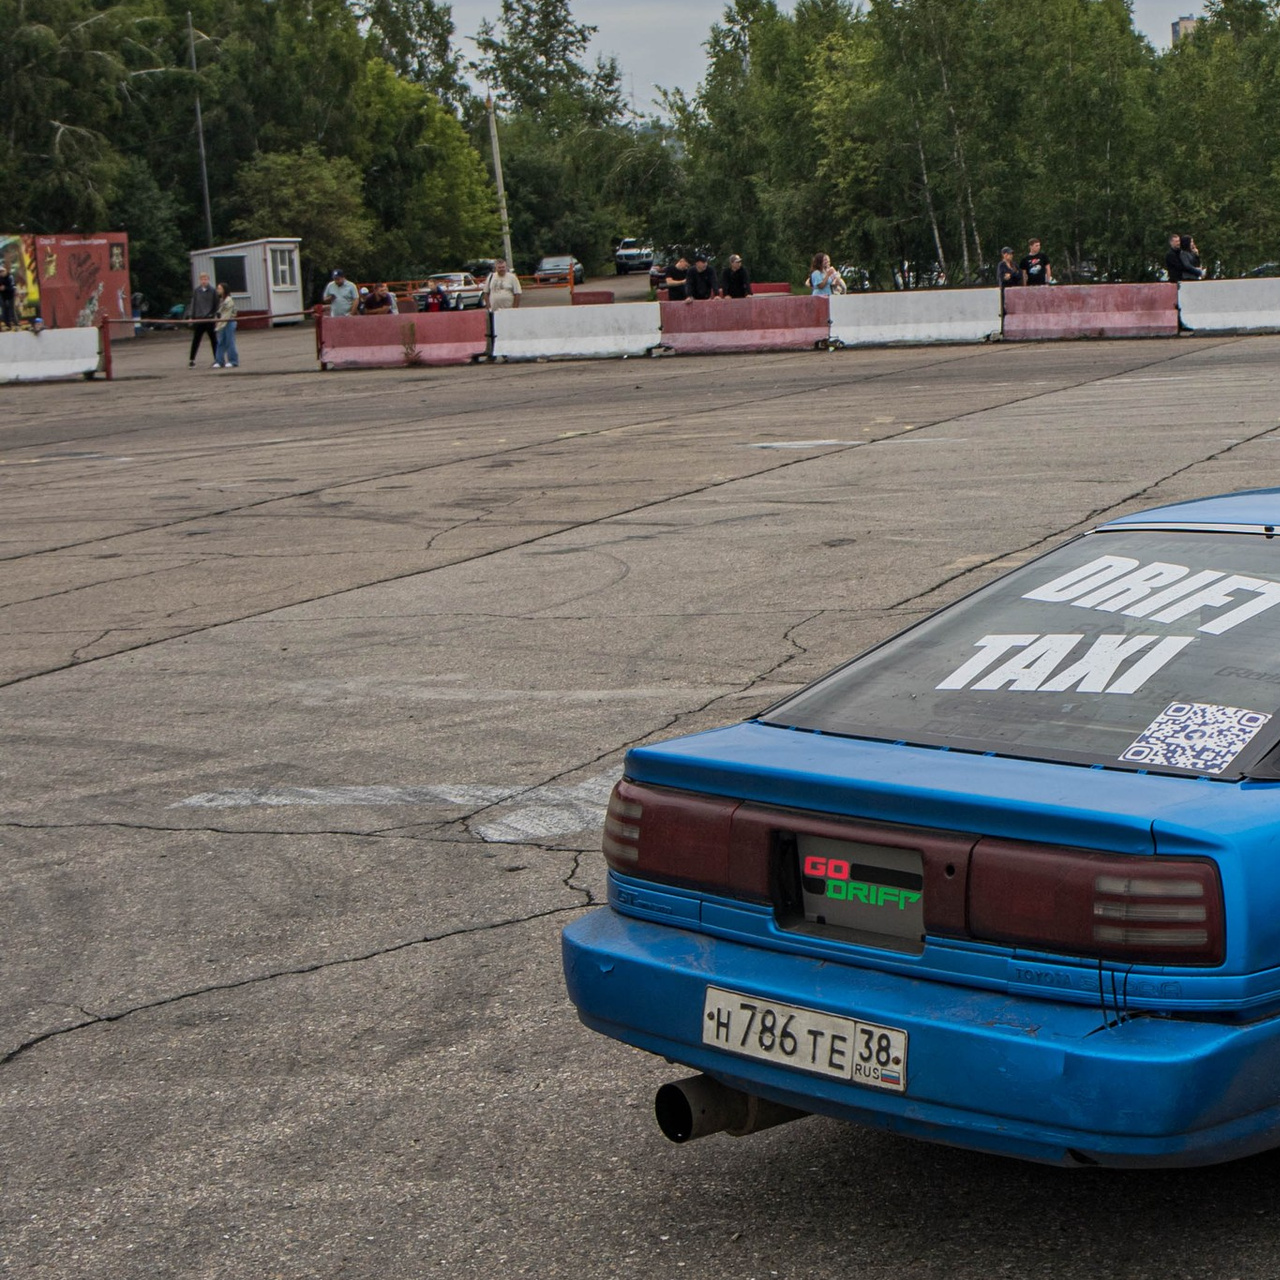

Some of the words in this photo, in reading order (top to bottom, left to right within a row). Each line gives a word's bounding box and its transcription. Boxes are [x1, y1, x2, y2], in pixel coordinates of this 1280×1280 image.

[935, 634, 1196, 694] TAXI
[804, 855, 850, 880] GO
[826, 879, 922, 910] DRIFT
[1015, 968, 1073, 987] TOYOTA
[859, 1028, 891, 1067] 38
[854, 1063, 880, 1080] RUS
